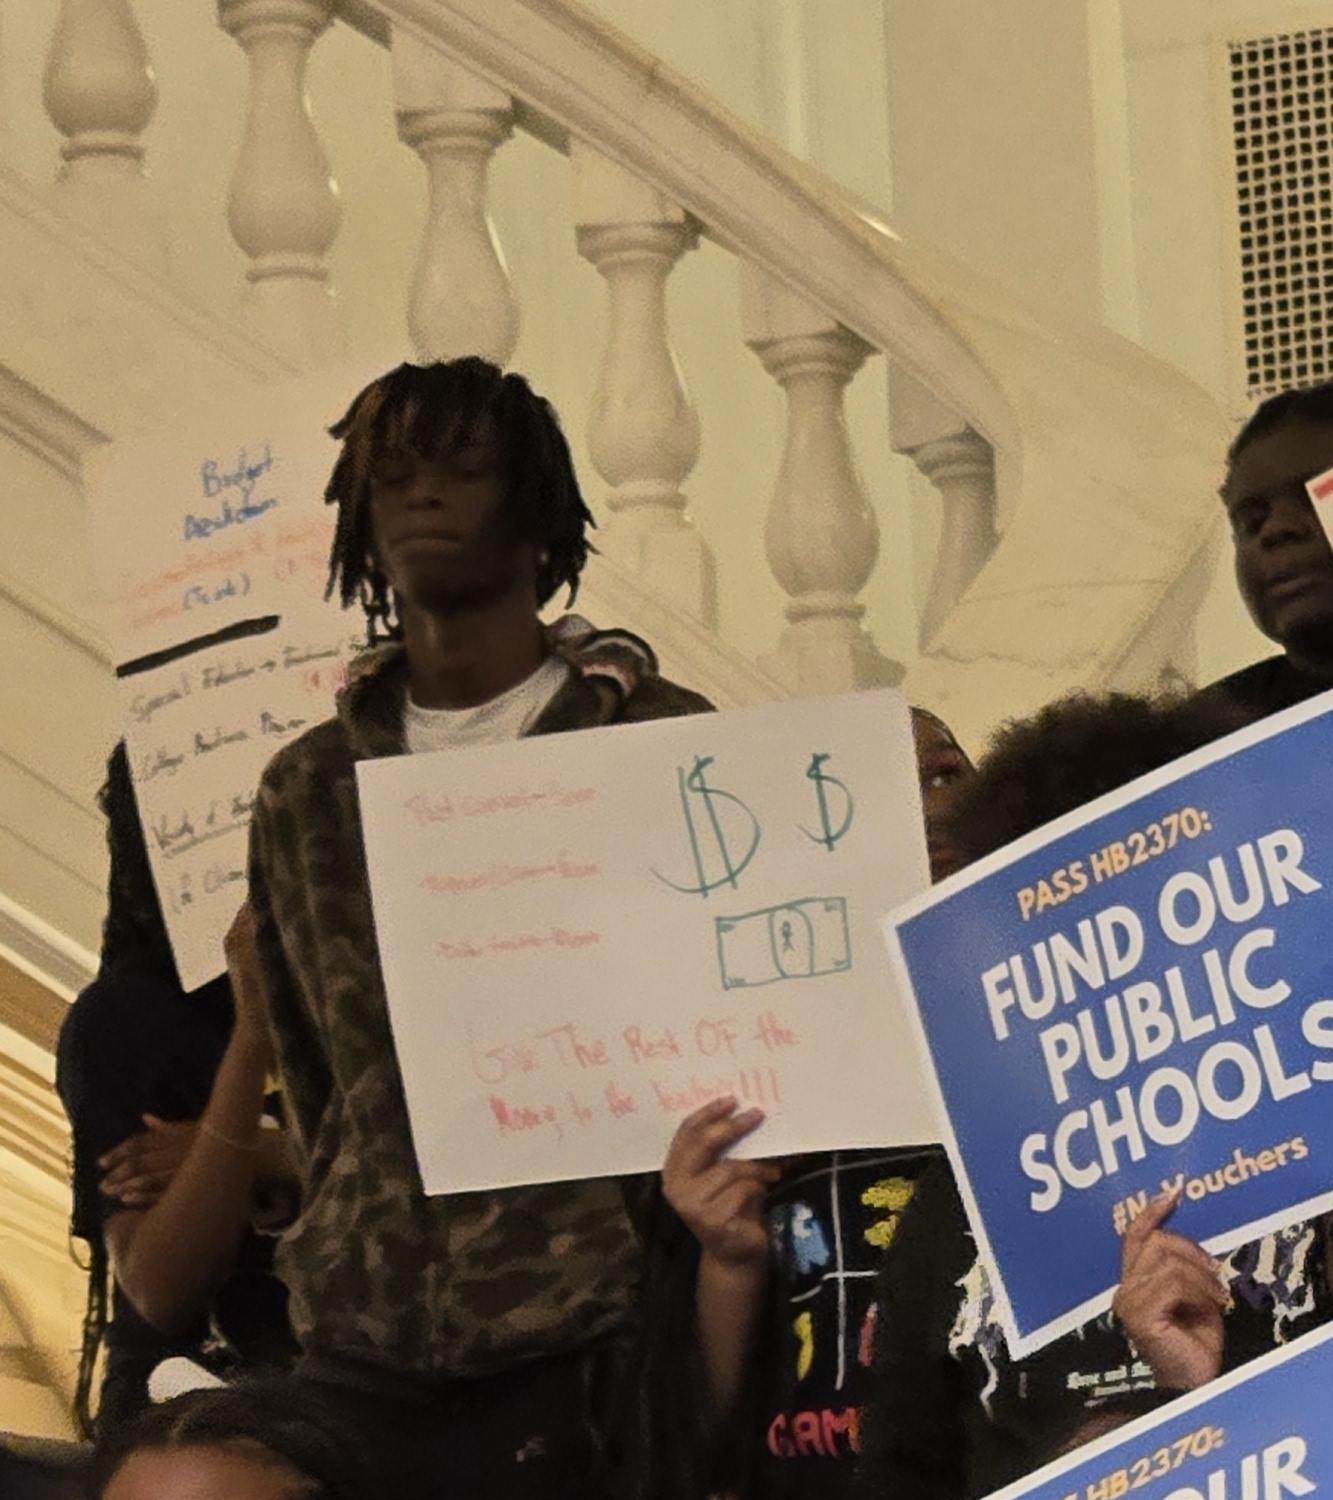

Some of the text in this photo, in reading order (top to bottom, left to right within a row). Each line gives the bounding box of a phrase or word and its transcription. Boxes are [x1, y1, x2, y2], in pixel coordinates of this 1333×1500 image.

[981, 827, 1322, 1041] FUND OUR
[1016, 807, 1212, 921] PASS HB2370:
[1039, 928, 1292, 1104] PUBLIC
[1111, 1135, 1309, 1234] #NVouchers
